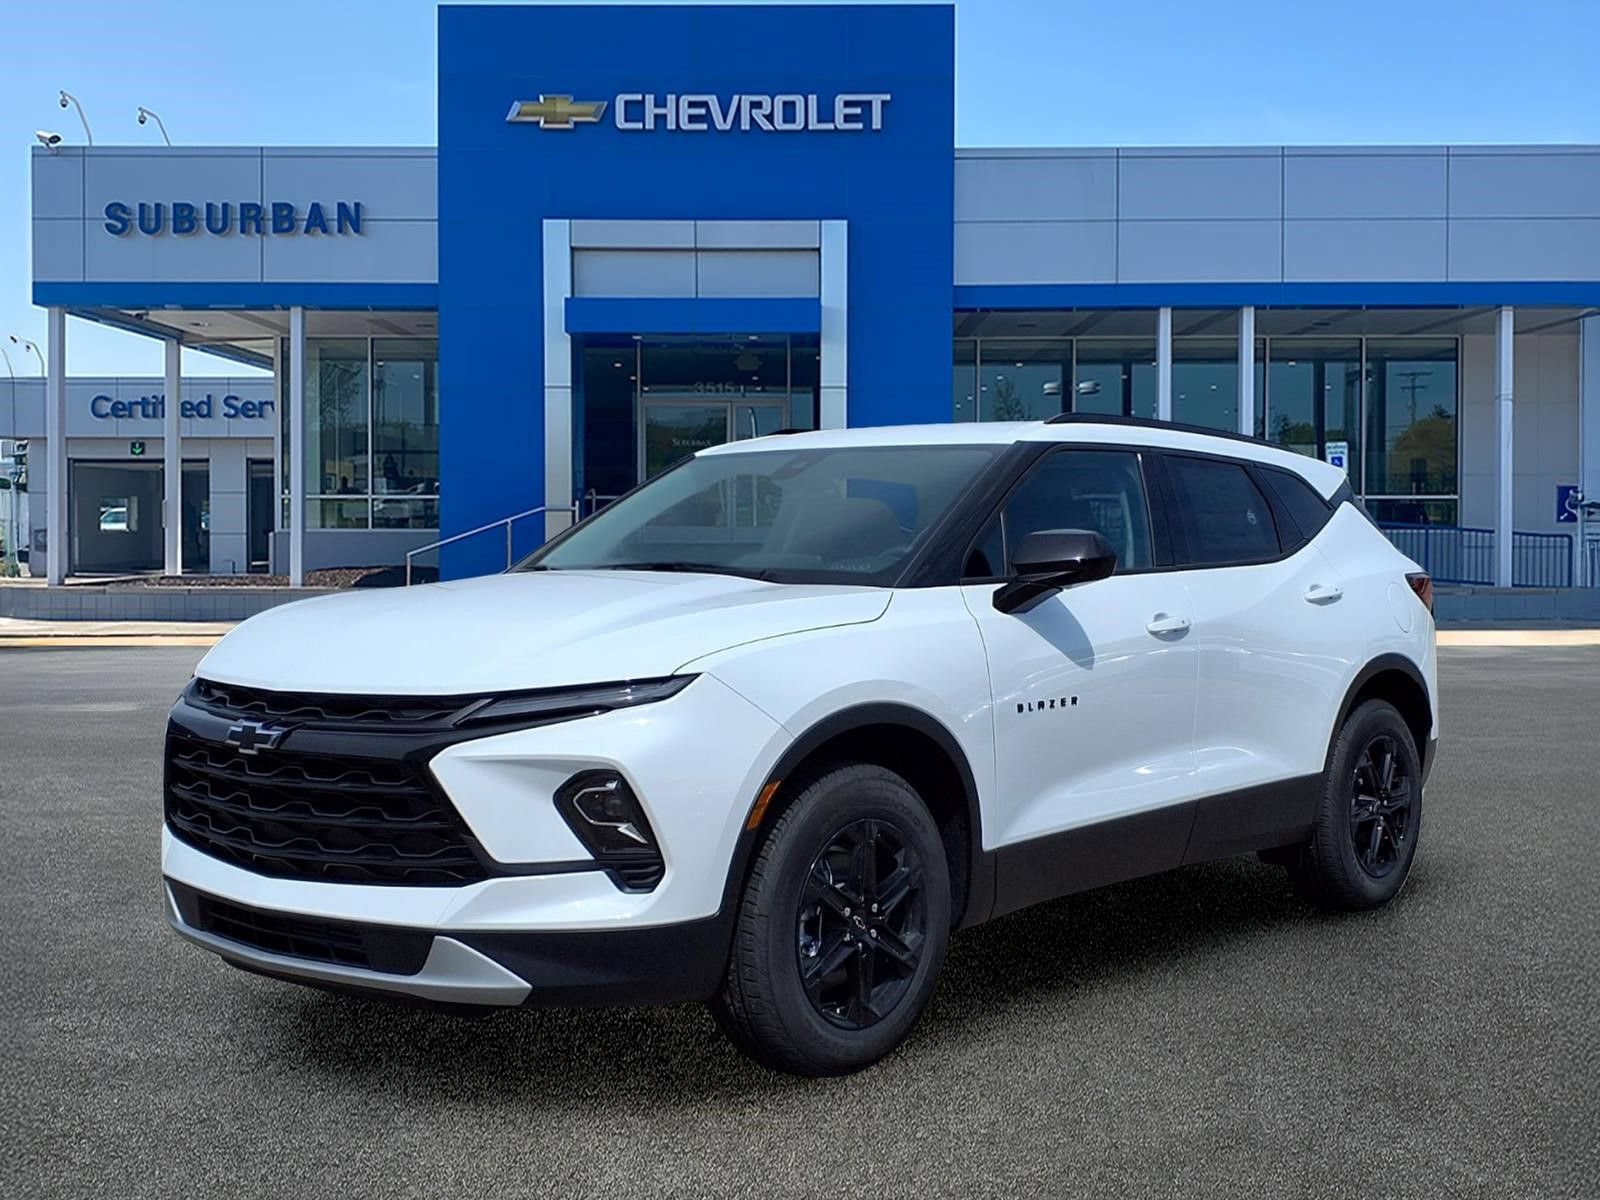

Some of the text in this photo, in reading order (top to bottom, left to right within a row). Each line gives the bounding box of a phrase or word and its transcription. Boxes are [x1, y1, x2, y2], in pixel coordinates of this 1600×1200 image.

[615, 93, 891, 131] CHEVROLET
[104, 201, 364, 236] SUBURBAN
[91, 394, 212, 419] Certifed
[1017, 696, 1078, 713] BLAZER
